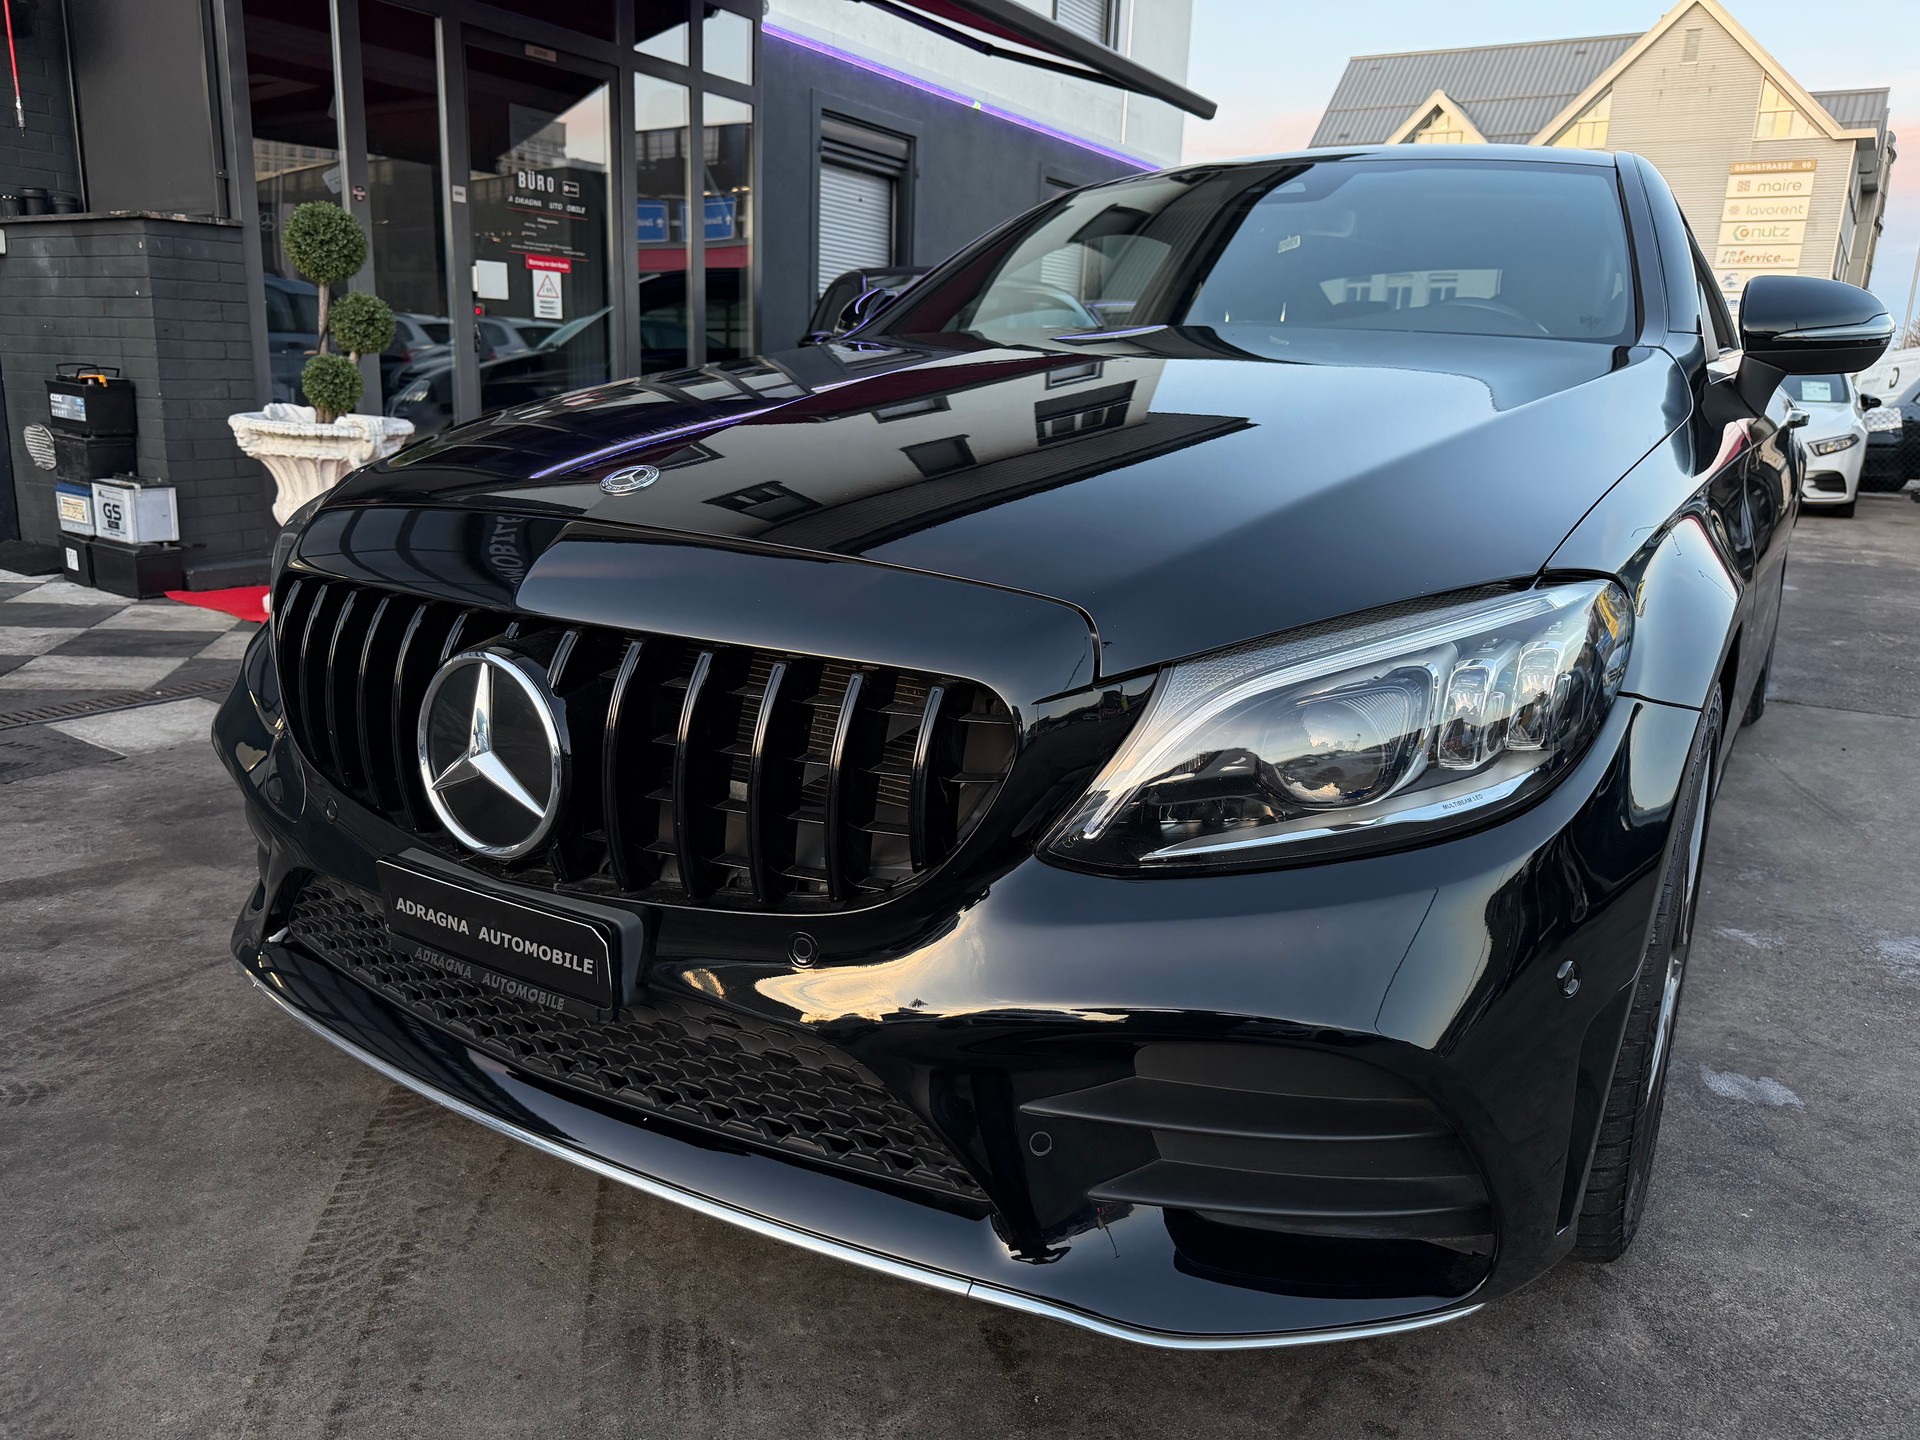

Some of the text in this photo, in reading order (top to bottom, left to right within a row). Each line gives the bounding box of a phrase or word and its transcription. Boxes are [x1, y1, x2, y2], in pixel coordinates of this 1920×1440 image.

[517, 170, 555, 193] BÜRO
[1757, 178, 1802, 192] maire
[1746, 204, 1804, 217] lavorent
[103, 502, 122, 521] GS
[1442, 794, 1483, 809] MULTIBEAM LED
[396, 897, 594, 976] ADRAGNA AUTOMOBILE
[415, 947, 566, 1011] ADRAGNA AUTOMOBILE
